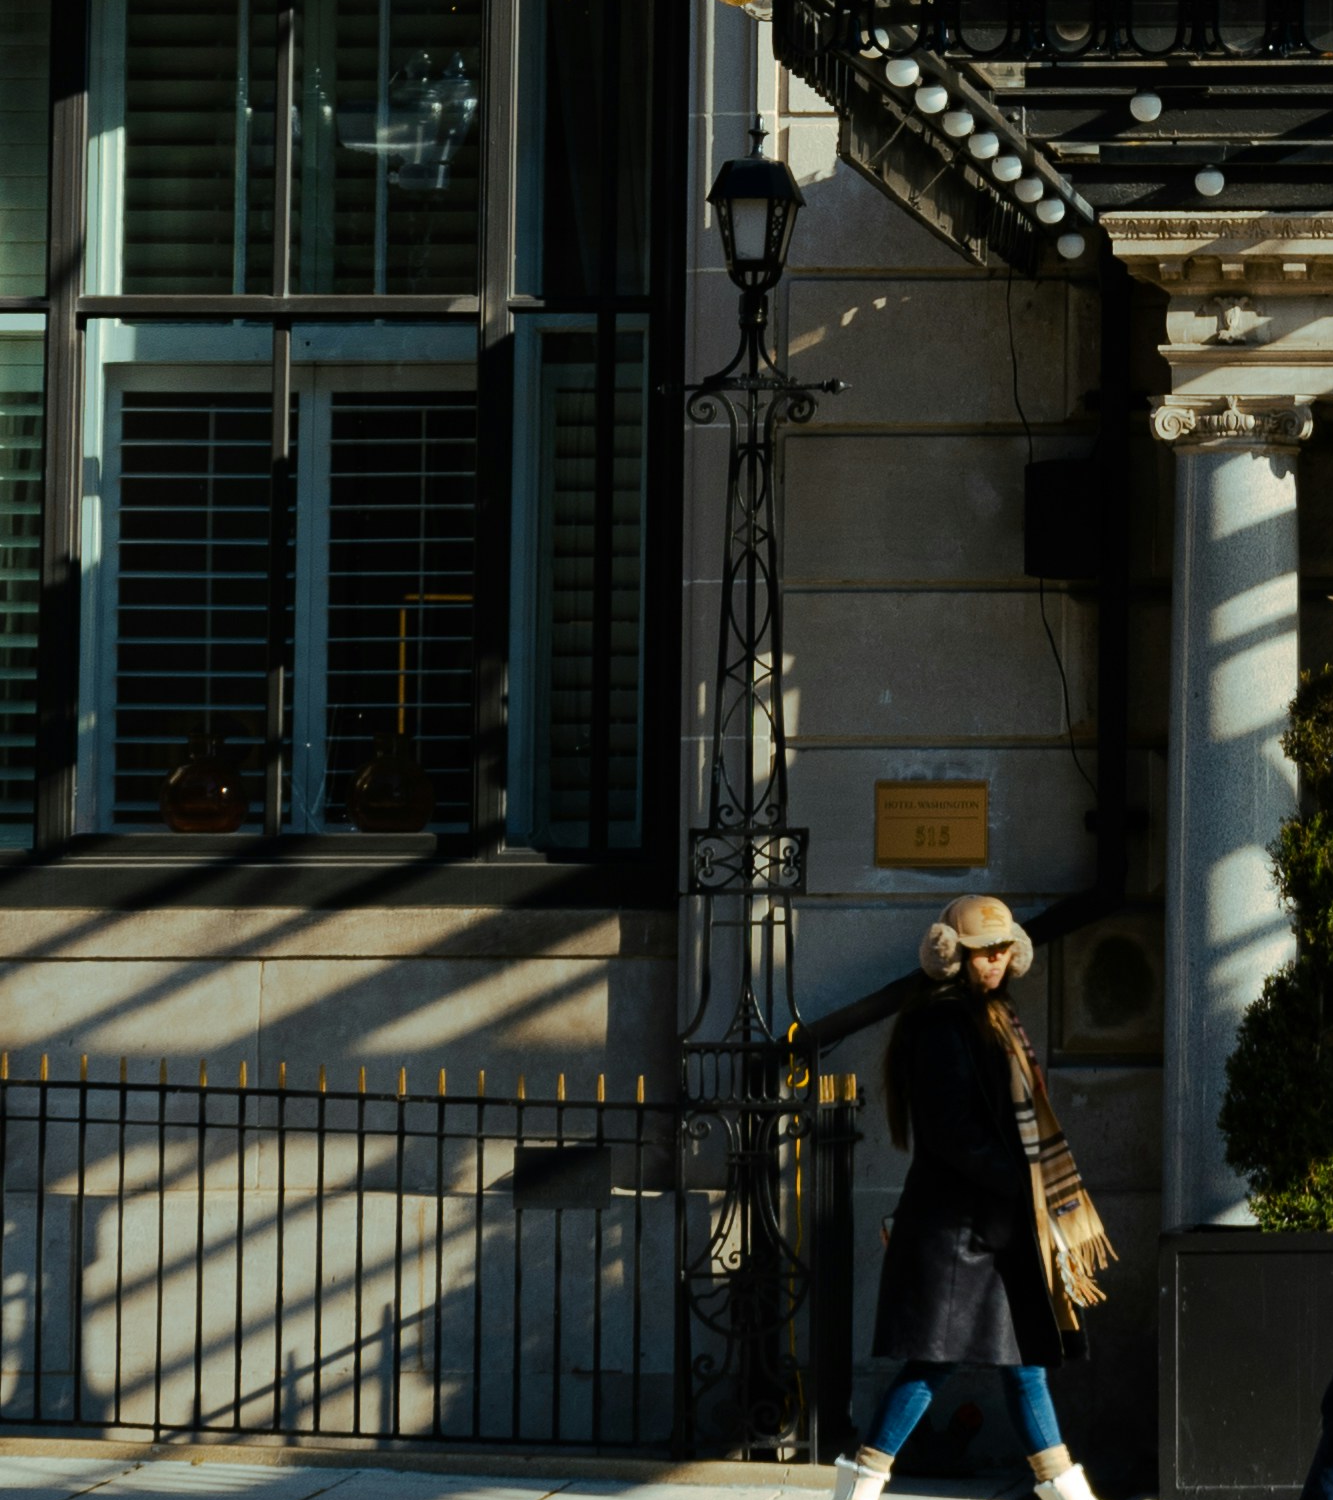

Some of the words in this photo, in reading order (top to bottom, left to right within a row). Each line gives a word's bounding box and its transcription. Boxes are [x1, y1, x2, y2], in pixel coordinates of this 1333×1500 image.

[884, 801, 916, 809] HOTEL
[918, 801, 979, 809] WASHINGTON
[914, 825, 951, 847] 515
